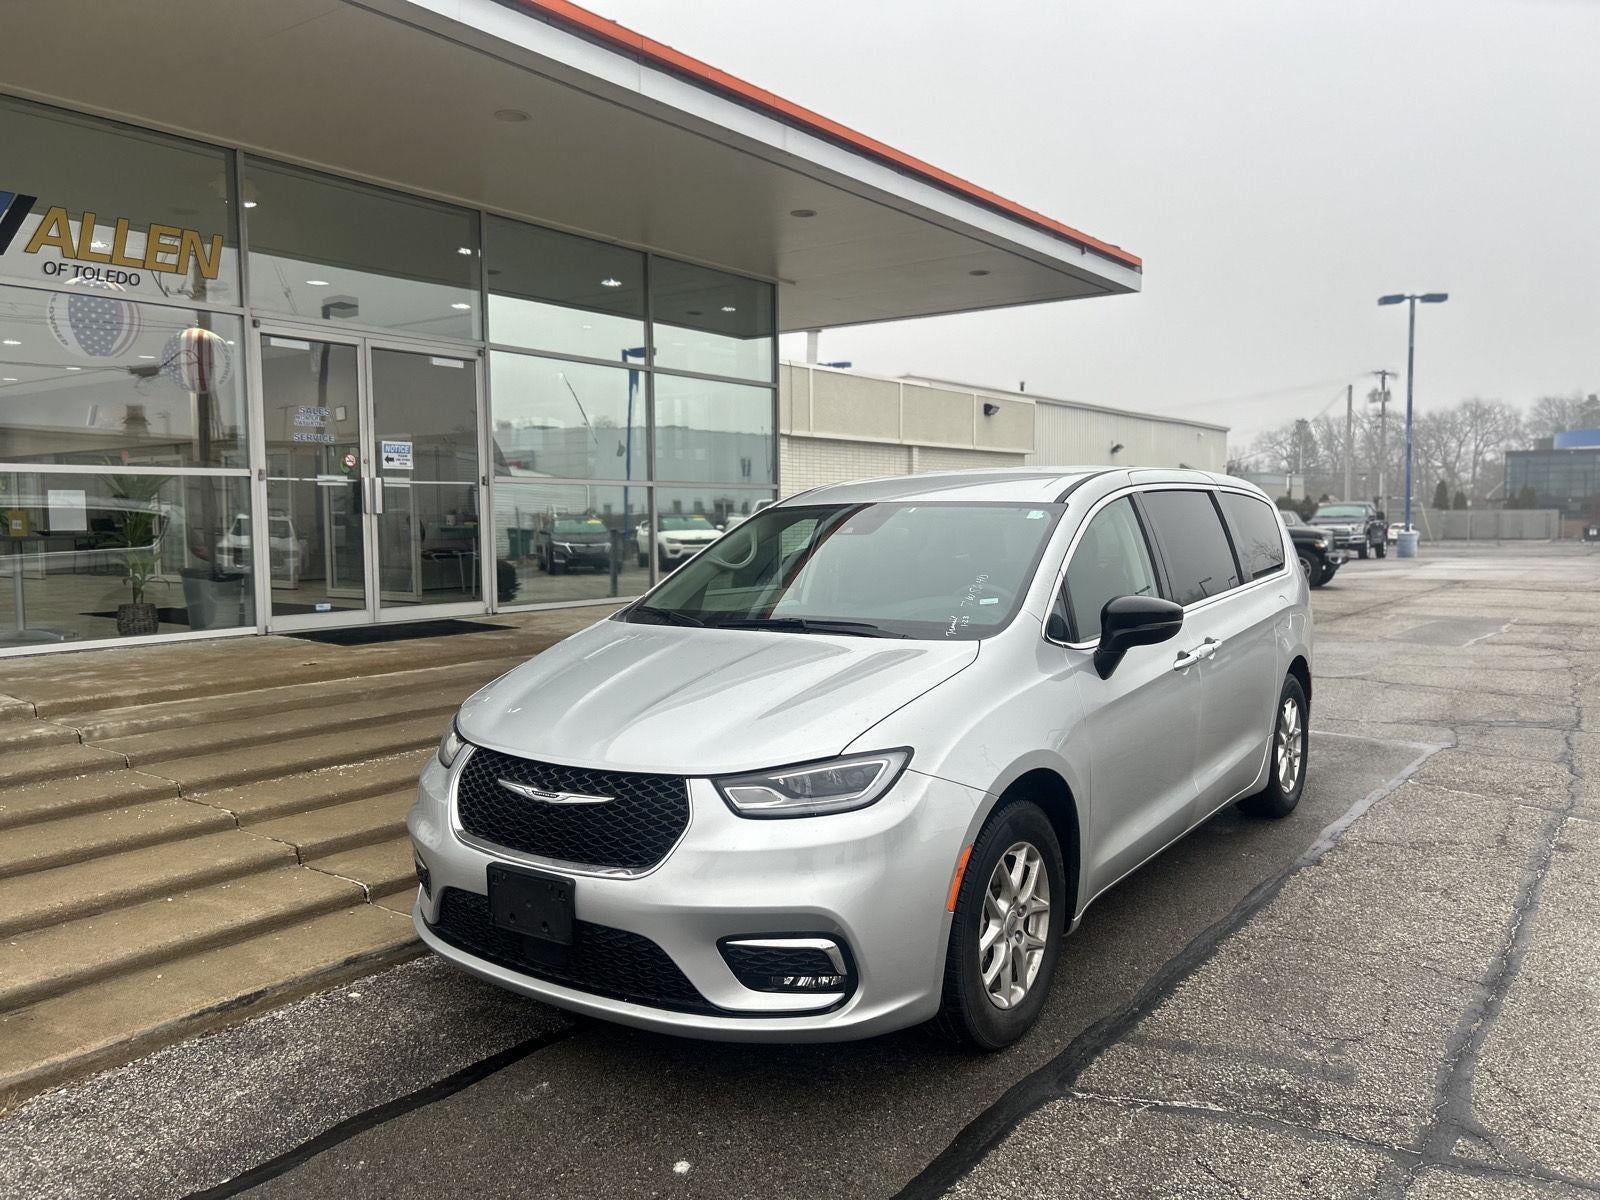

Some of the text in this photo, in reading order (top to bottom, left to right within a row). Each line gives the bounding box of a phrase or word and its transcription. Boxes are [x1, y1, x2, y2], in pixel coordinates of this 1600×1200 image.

[25, 205, 224, 280] ALLEN
[43, 261, 141, 287] OF TOLEDO
[299, 406, 331, 416] SALES
[293, 433, 335, 443] SERVICE
[385, 445, 410, 454] NOTICE
